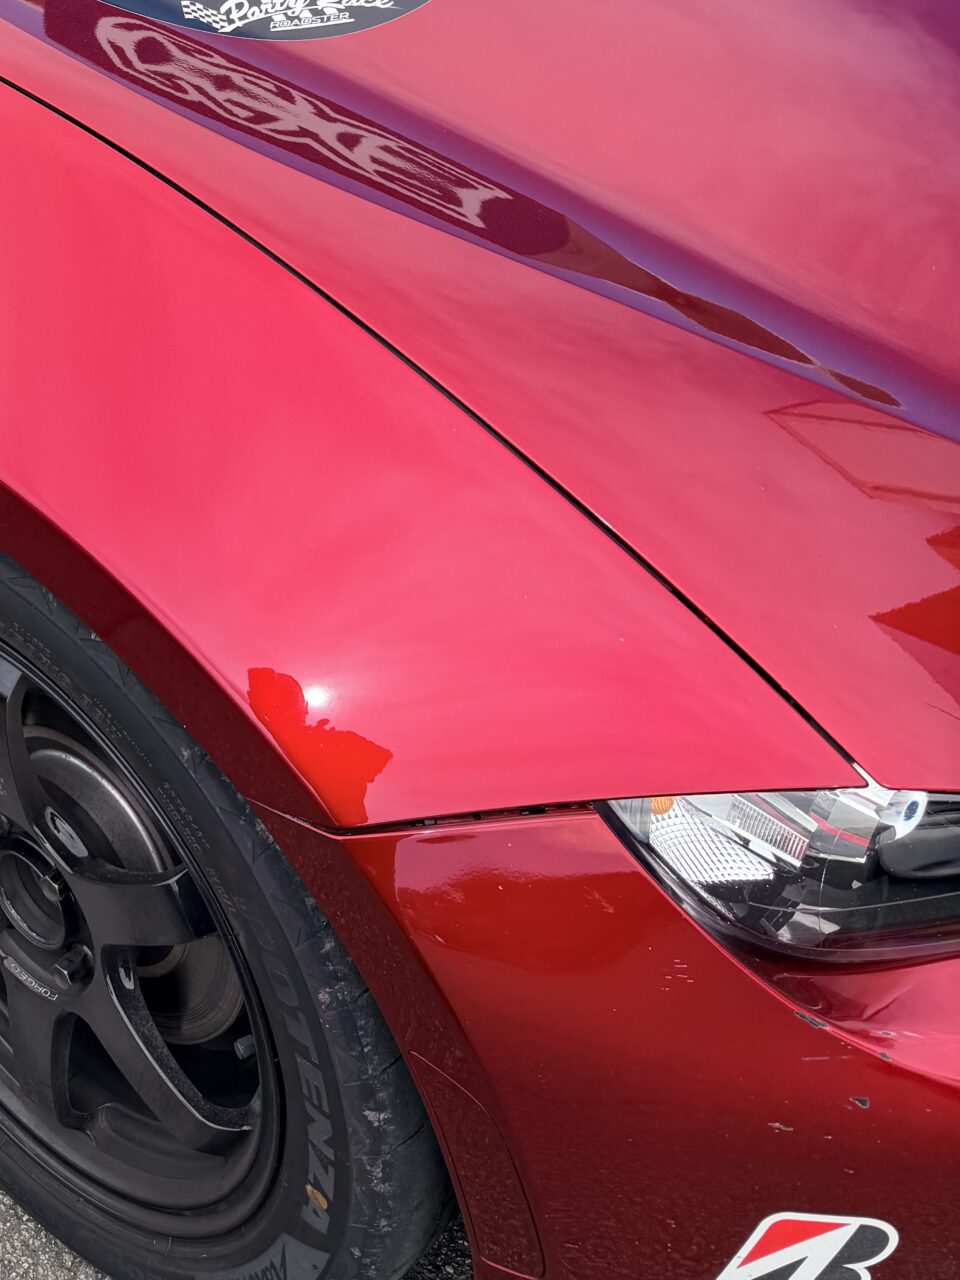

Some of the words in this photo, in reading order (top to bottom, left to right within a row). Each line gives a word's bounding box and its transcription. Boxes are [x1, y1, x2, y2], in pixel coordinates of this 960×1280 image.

[270, 11, 351, 29] ROADSTER
[10, 963, 59, 1001] FORGED
[243, 902, 335, 1235] POTENZA
